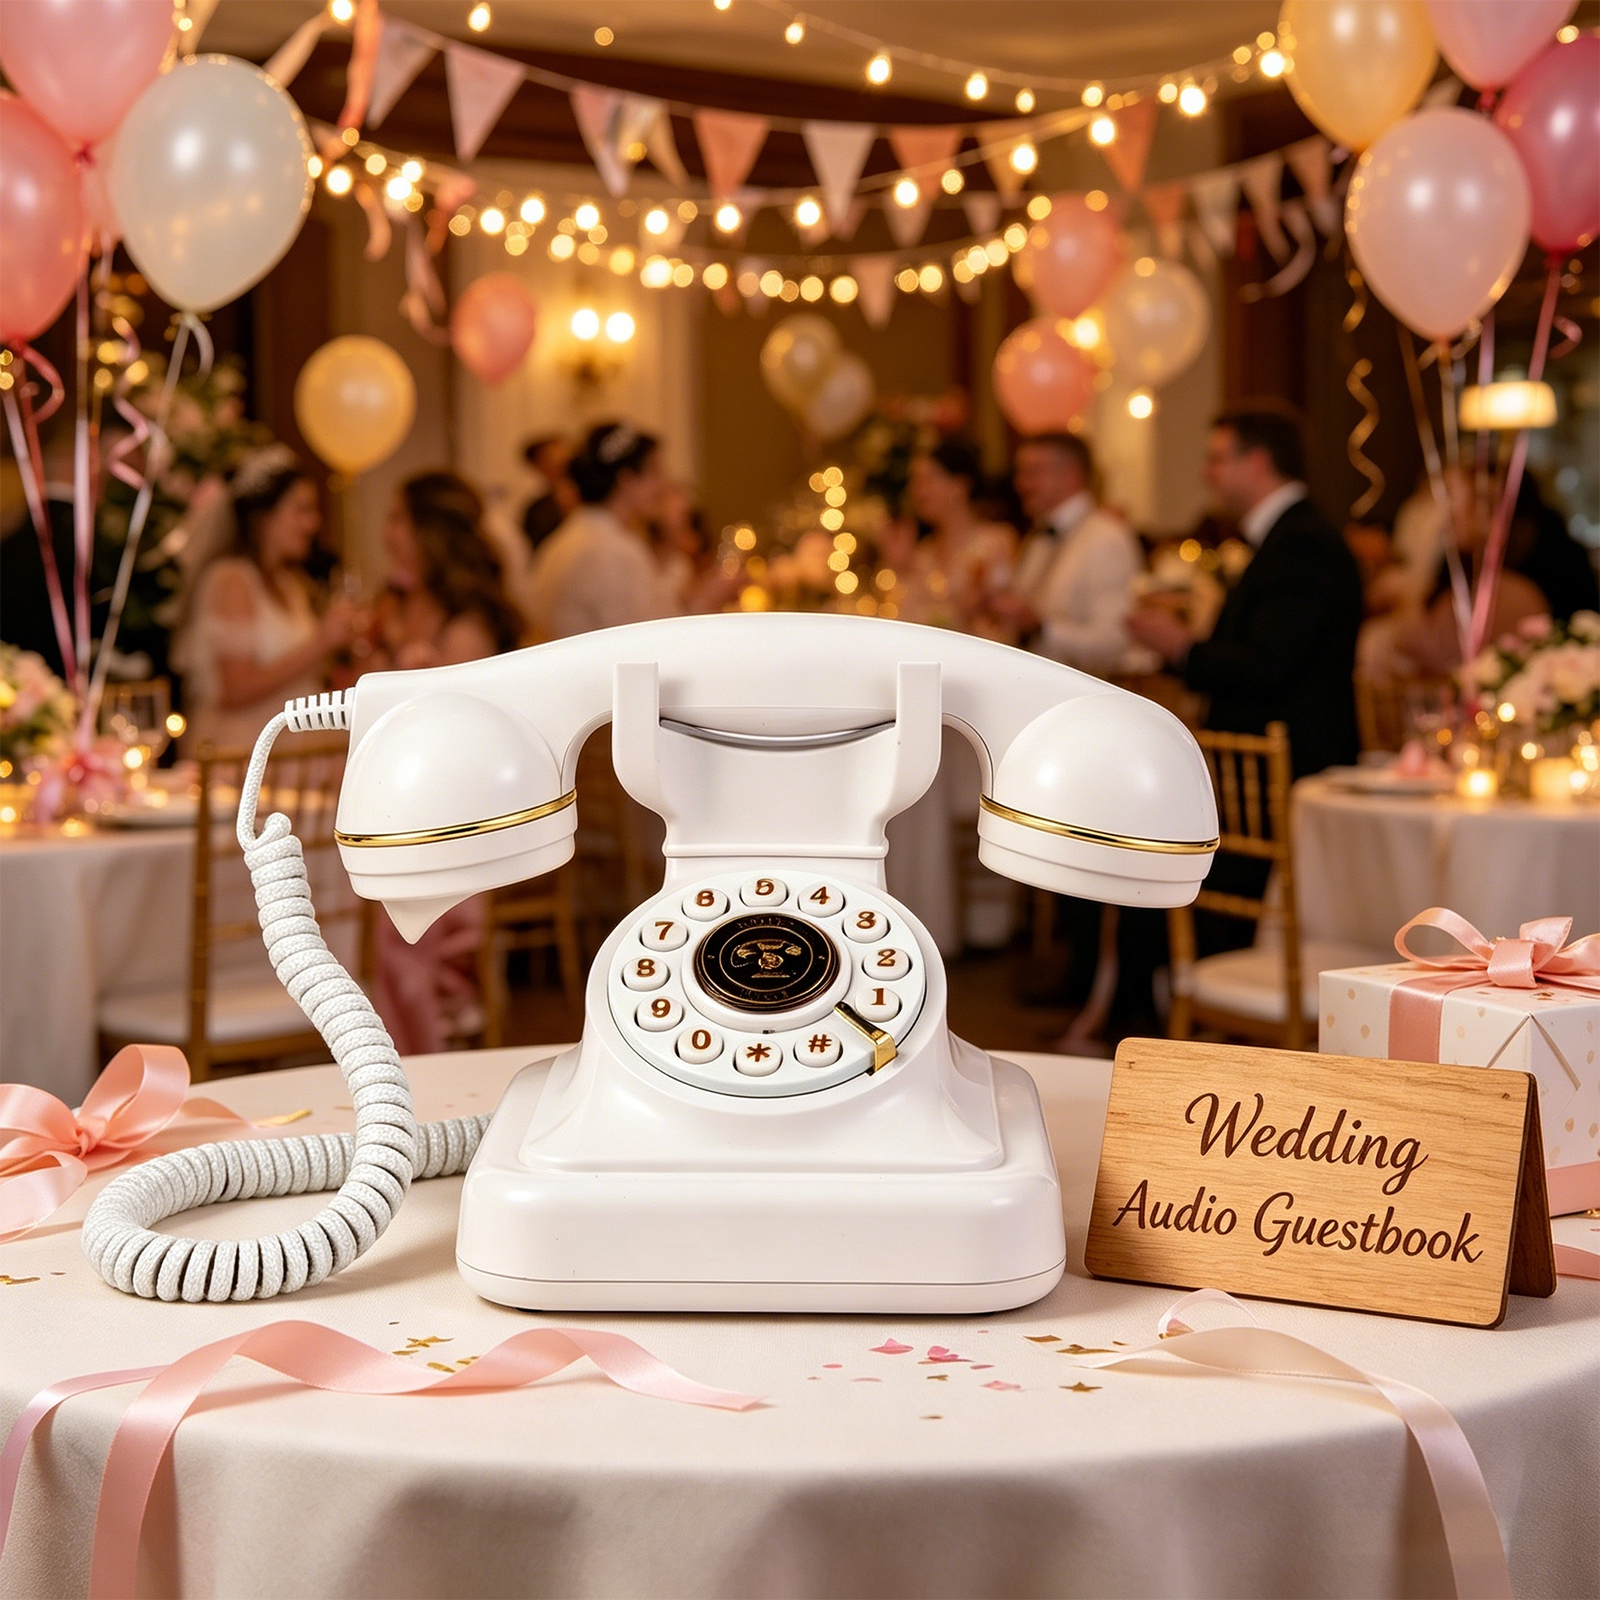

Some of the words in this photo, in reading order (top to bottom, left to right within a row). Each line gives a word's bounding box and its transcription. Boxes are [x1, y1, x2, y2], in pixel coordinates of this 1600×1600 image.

[809, 886, 831, 905] 4
[655, 920, 675, 940] 7
[876, 948, 897, 968] 2
[871, 988, 887, 1006] 1
[651, 998, 671, 1018] 9
[691, 1029, 711, 1050] 0
[1185, 1092, 1429, 1196] Wedding
[1111, 1179, 1238, 1235] Audio
[1253, 1191, 1484, 1263] Guestbook
